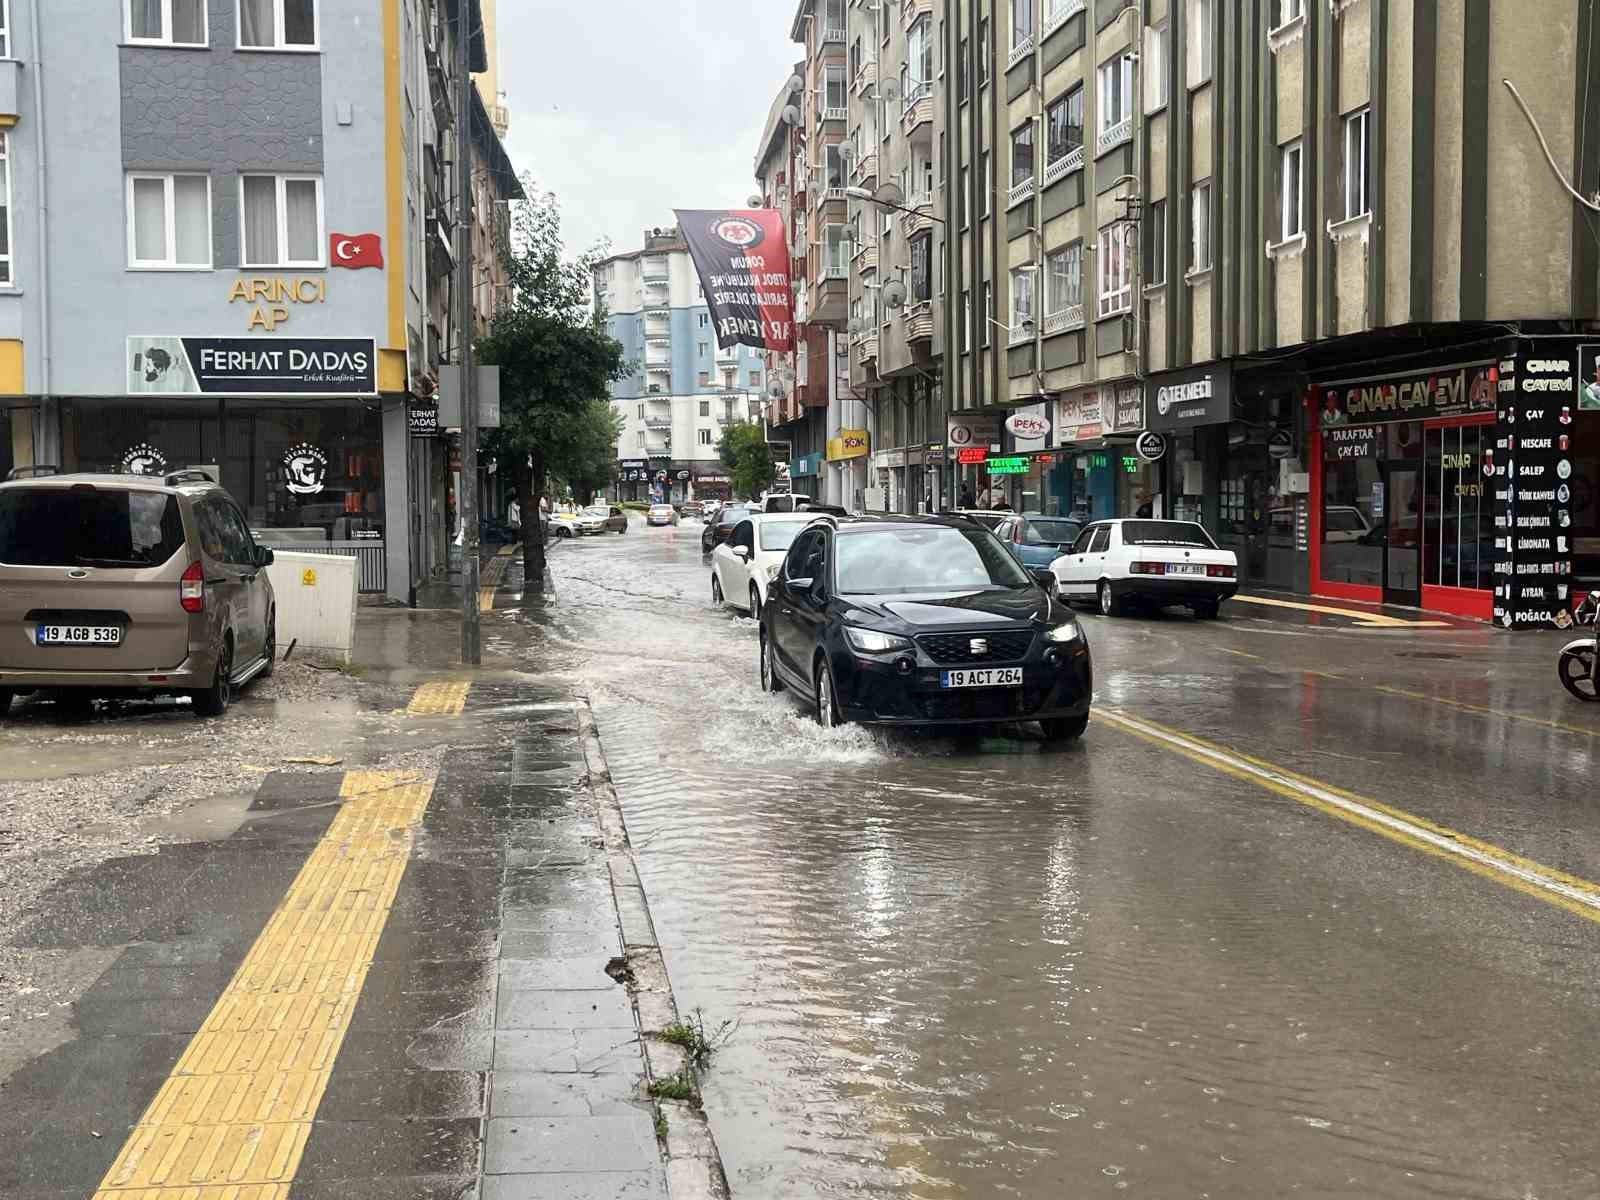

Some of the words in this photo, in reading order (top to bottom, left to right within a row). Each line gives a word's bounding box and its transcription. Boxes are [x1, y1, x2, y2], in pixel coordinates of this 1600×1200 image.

[248, 306, 289, 331] AP
[201, 348, 284, 371] FERHAT
[289, 349, 368, 373] DADAŞ
[1399, 380, 1431, 411] ÇAY
[1525, 410, 1544, 421] ÇAY
[1332, 429, 1374, 441] TARAFTAR
[1519, 465, 1545, 476] SALEP
[46, 627, 59, 640] 19
[65, 627, 90, 641] AGB
[94, 628, 119, 641] 538
[950, 672, 965, 686] 19
[968, 670, 993, 685] ACT
[997, 669, 1021, 684] 264
